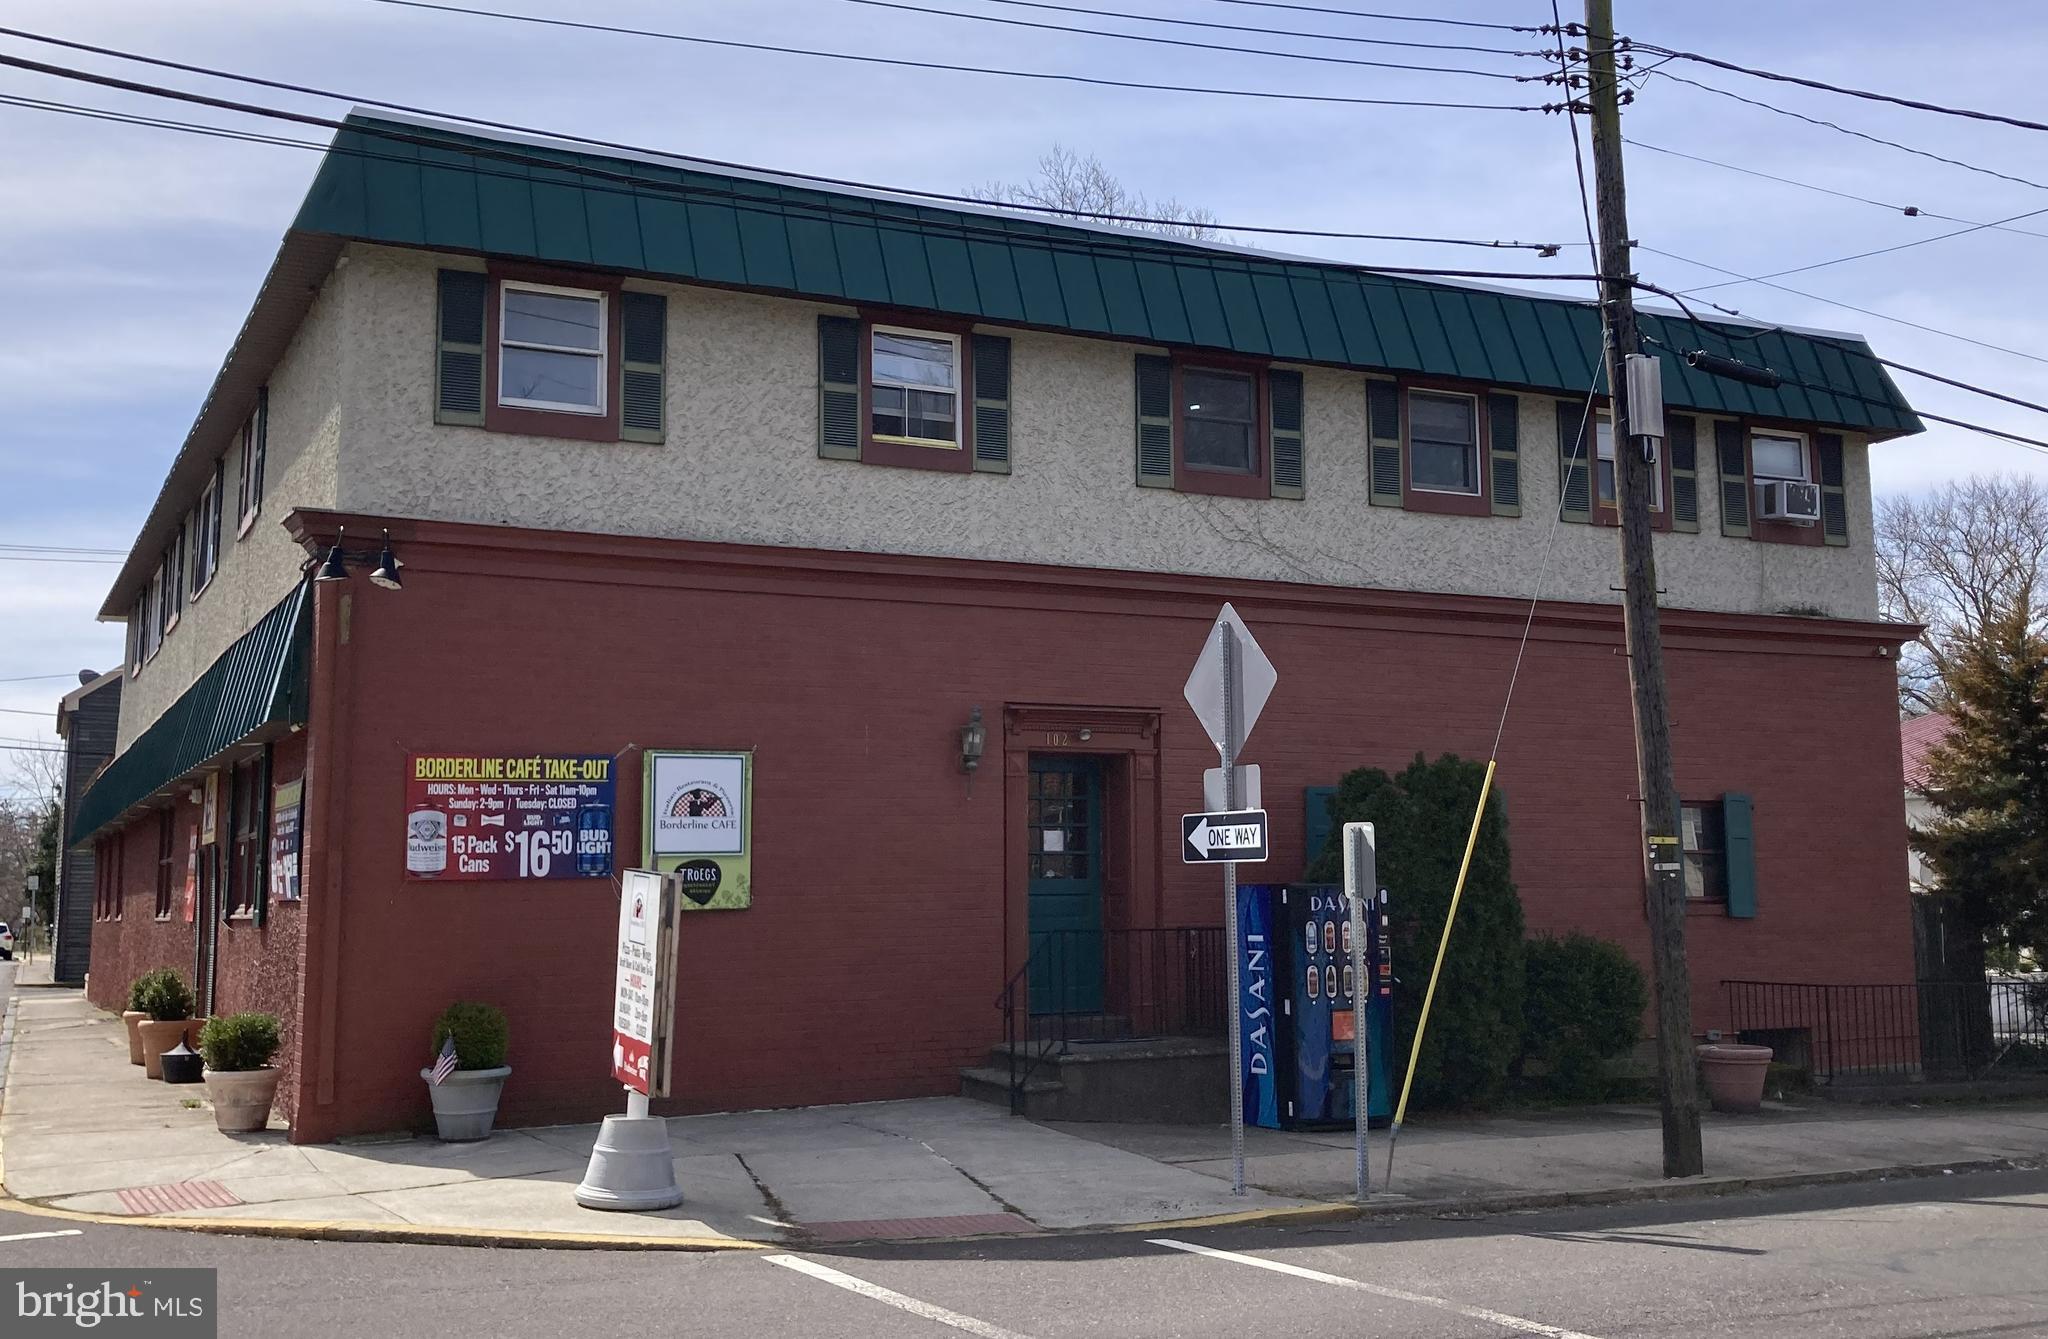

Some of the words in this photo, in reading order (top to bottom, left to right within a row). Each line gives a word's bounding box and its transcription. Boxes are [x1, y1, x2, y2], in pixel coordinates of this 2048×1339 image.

[1046, 732, 1068, 746] 102
[415, 758, 504, 778] BORDERLINE
[506, 755, 541, 778] CAFÉ
[544, 759, 610, 779] TAKE-OUT
[427, 783, 456, 795] HOURS:
[457, 784, 474, 795] Mon
[480, 784, 497, 795] Wed
[502, 784, 523, 796] Thurs
[529, 784, 540, 796] Fri
[545, 784, 558, 796] Sat
[559, 784, 597, 797] 11am-10pm
[448, 798, 479, 811] Sunday:
[480, 798, 504, 810] 2-9pm
[515, 798, 548, 811] Tuesday:
[548, 798, 577, 809] CLOSED
[660, 819, 709, 830] Borderline
[711, 819, 737, 830] CAFE
[580, 829, 609, 841] BUD
[1208, 829, 1231, 846] ONE
[1234, 827, 1257, 845] WAY
[452, 835, 466, 854] 15
[467, 835, 498, 854] Pack
[577, 841, 612, 854] LIGHT
[459, 854, 490, 873] Cans
[1311, 891, 1374, 914] DASNI
[1244, 934, 1270, 1075] DASANI
